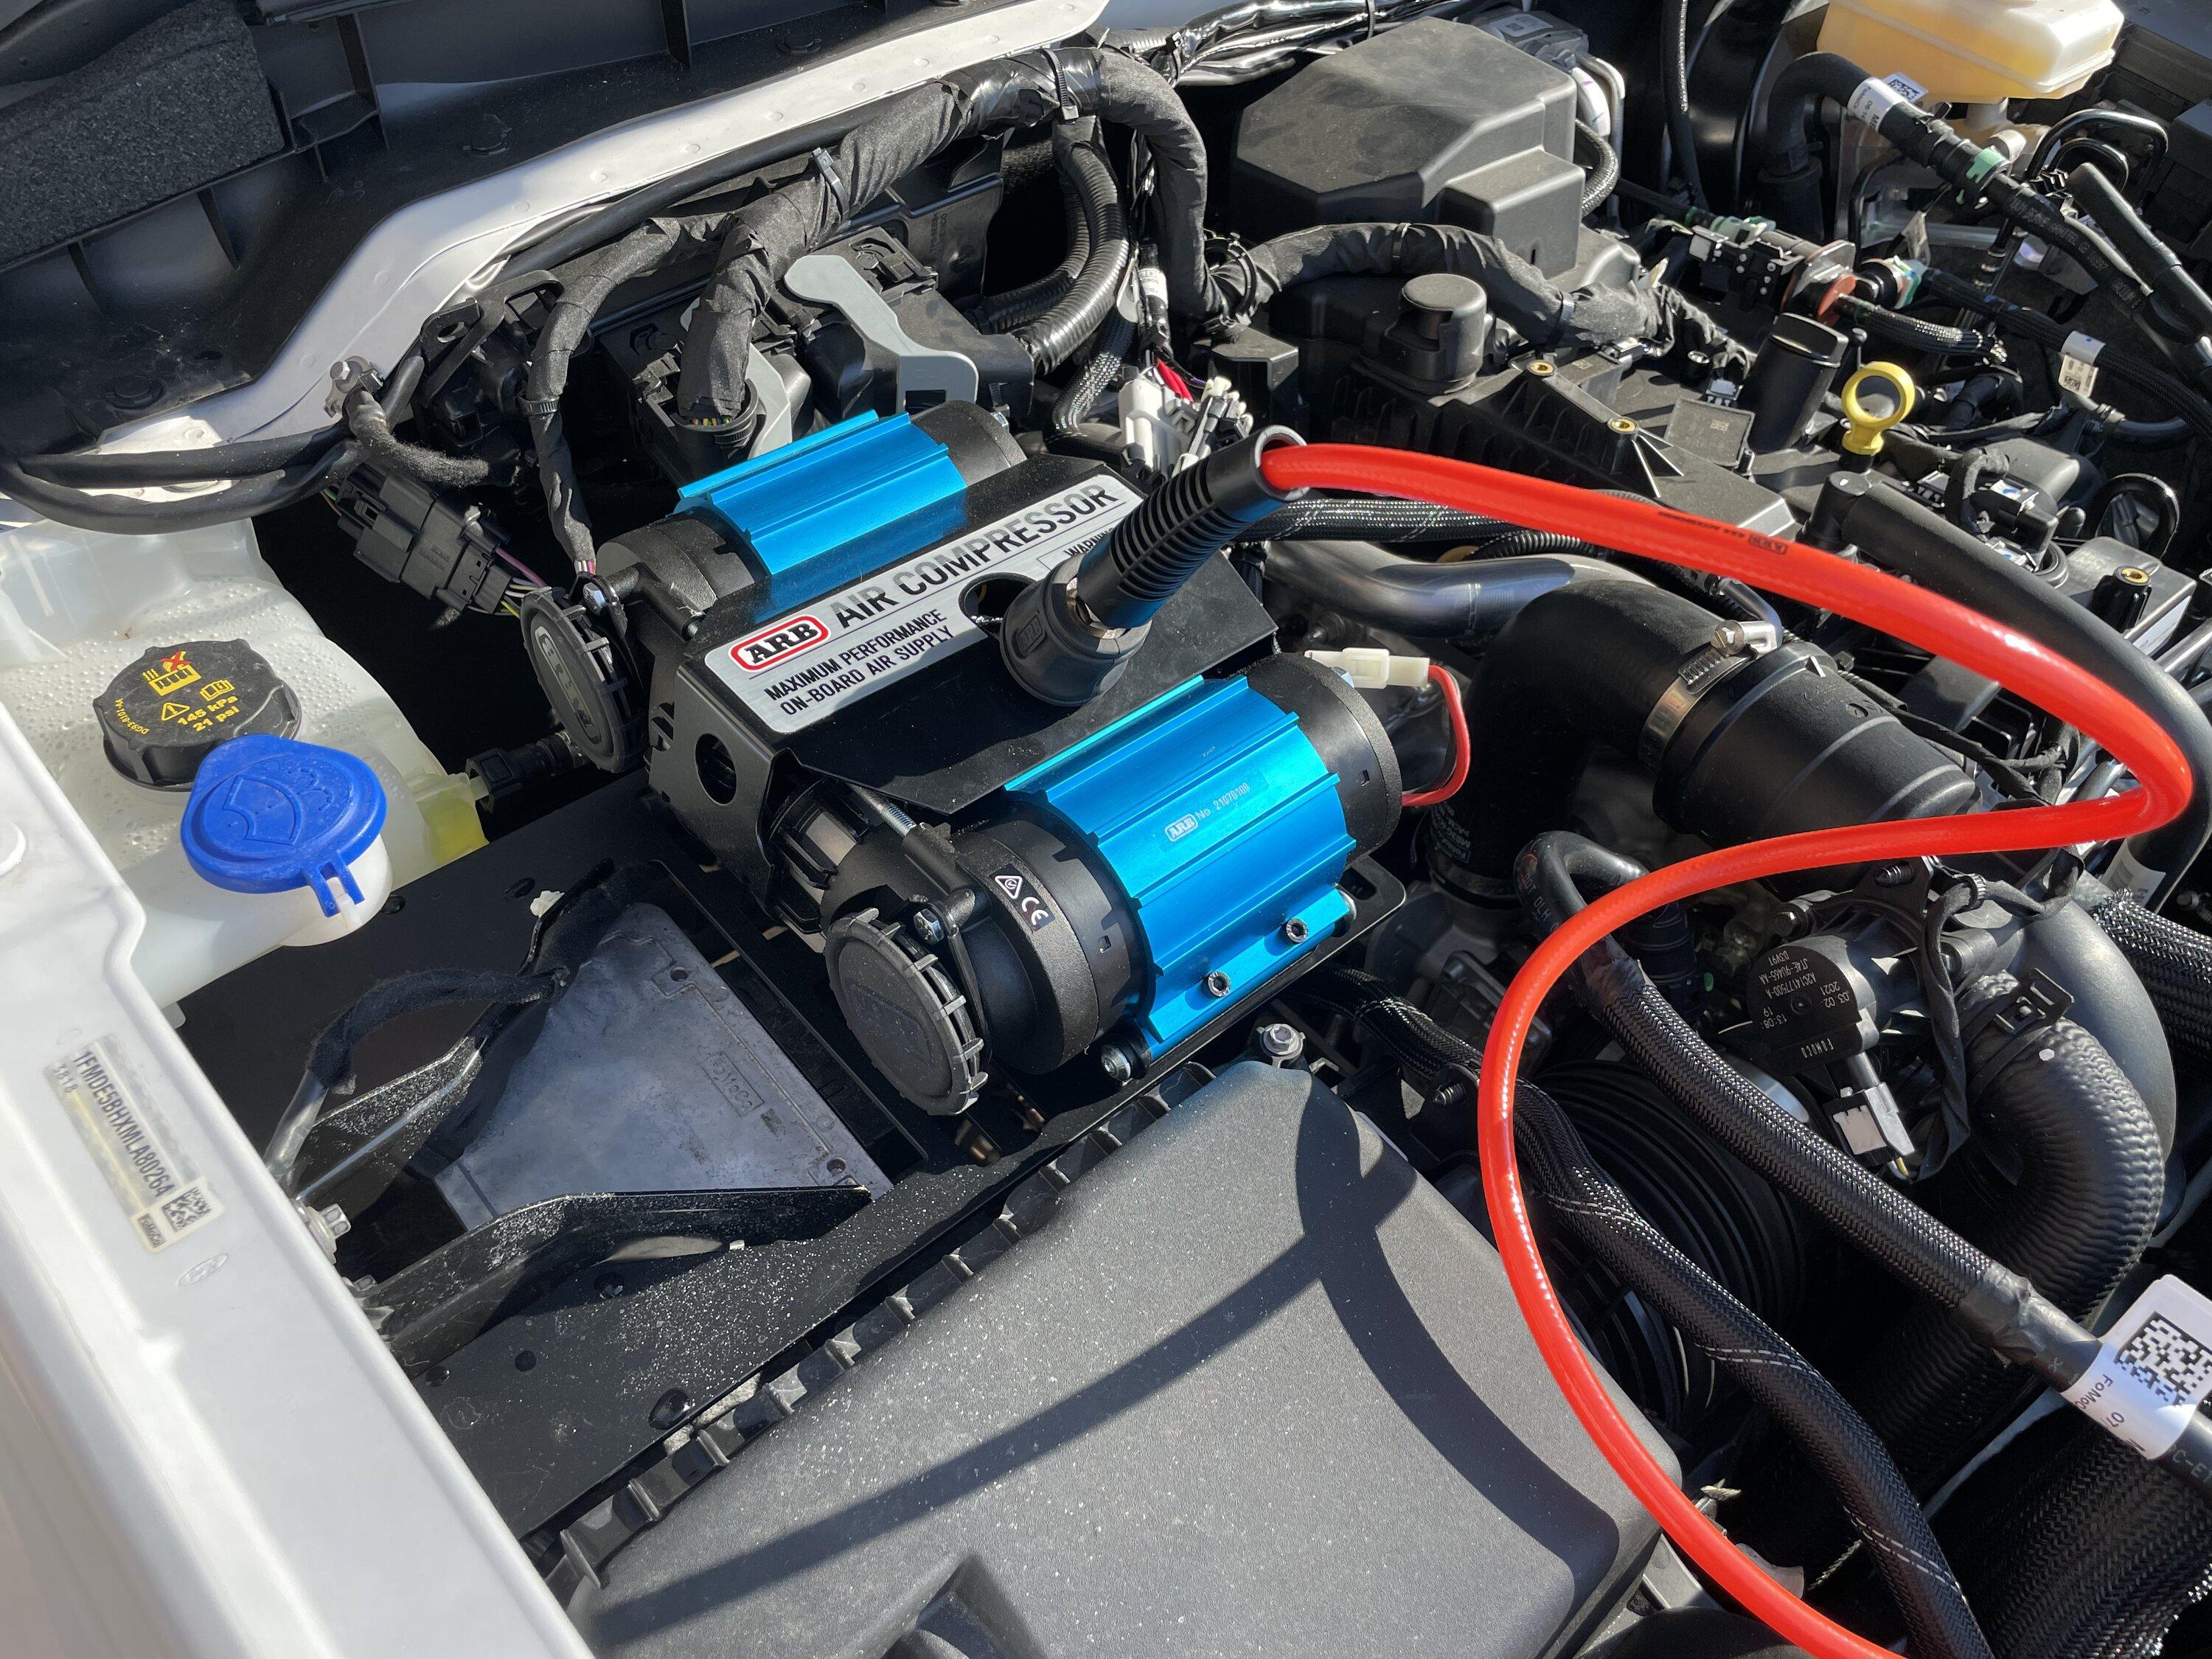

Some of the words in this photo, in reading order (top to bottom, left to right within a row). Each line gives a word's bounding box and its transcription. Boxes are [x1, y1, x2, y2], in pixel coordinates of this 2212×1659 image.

[830, 585, 900, 628] AIR
[891, 483, 1119, 597] COMPRESSOR
[1064, 526, 1114, 558] WARN
[745, 620, 820, 665] ARB
[764, 660, 838, 702] MAXIMUM
[841, 608, 948, 666] PERFORMANCE
[779, 668, 866, 717] ON-BOARD
[869, 650, 897, 677] AIR
[898, 624, 956, 661] SUPPLY
[176, 706, 207, 727] 145
[209, 695, 240, 713] kPa
[193, 717, 215, 733] 21
[217, 706, 240, 723] psi
[1820, 981, 1840, 995] 2021
[2074, 1374, 2114, 1411] FoMoC
